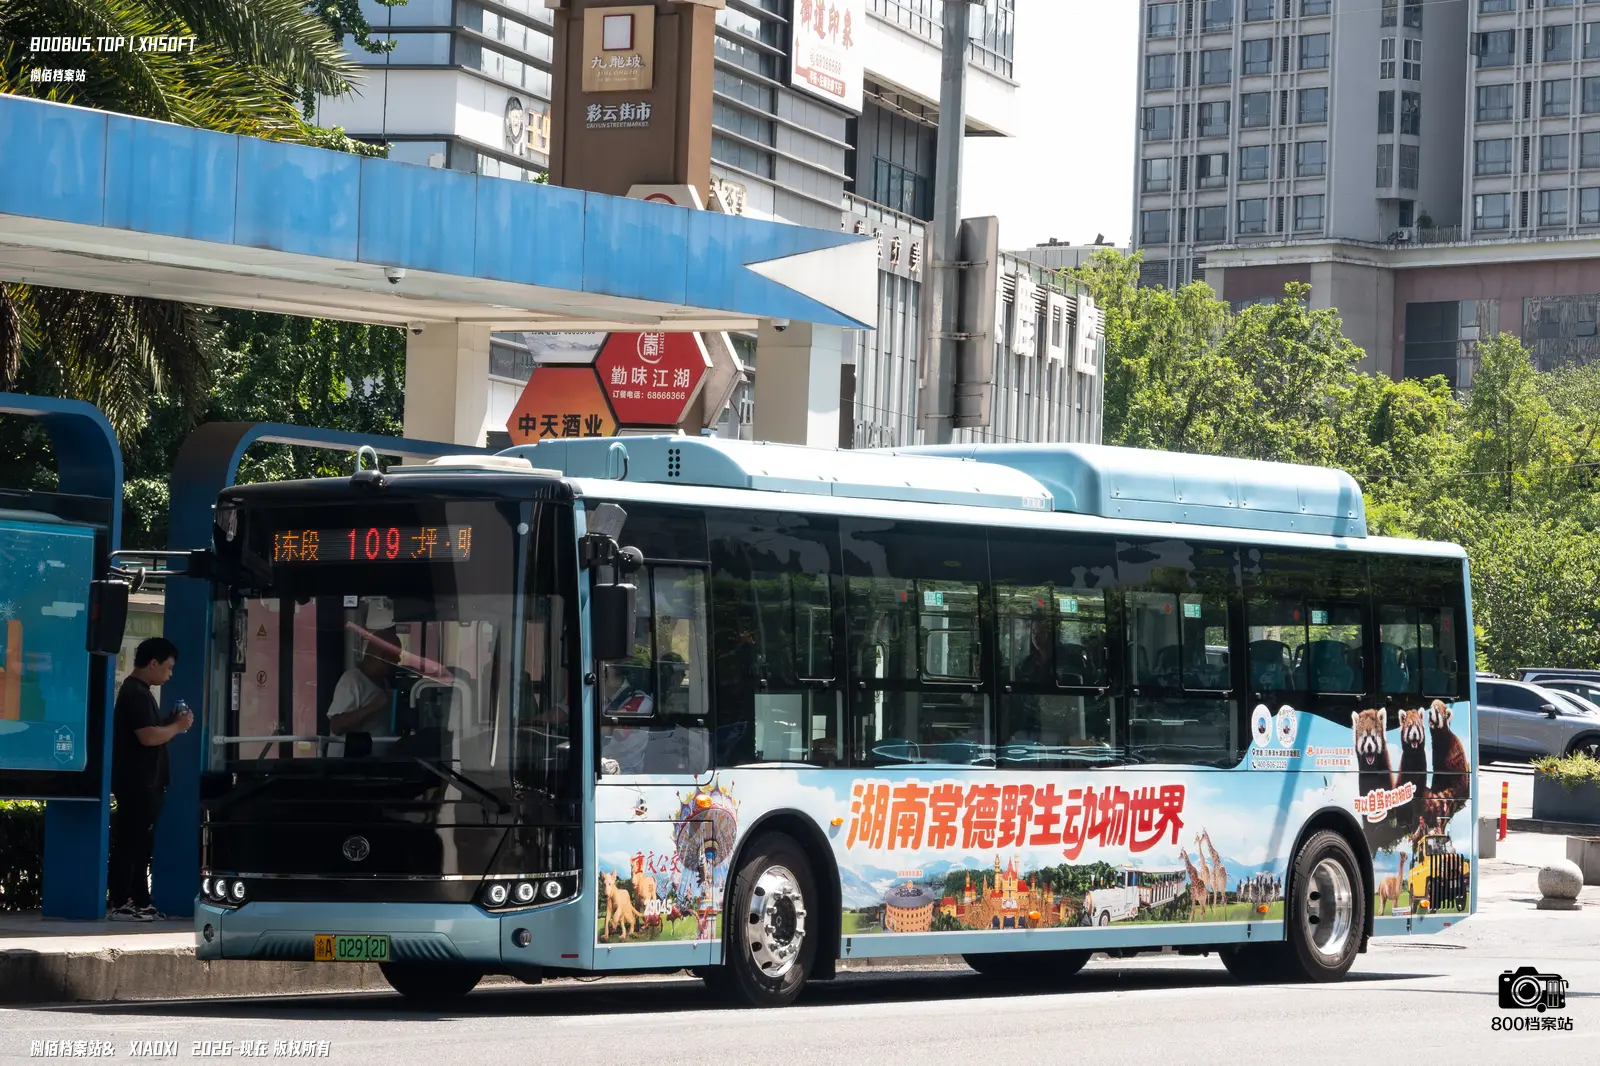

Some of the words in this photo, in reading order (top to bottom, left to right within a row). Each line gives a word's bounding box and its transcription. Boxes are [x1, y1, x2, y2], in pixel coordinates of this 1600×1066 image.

[586, 102, 652, 122] 彩云街市
[610, 365, 690, 388] 勤味江湖
[518, 413, 603, 438] 中天酒业
[348, 527, 400, 560] 109
[846, 783, 1186, 860] 湖南常德野生动物世界
[631, 850, 681, 875] 重庆公交
[644, 899, 673, 916] 29045
